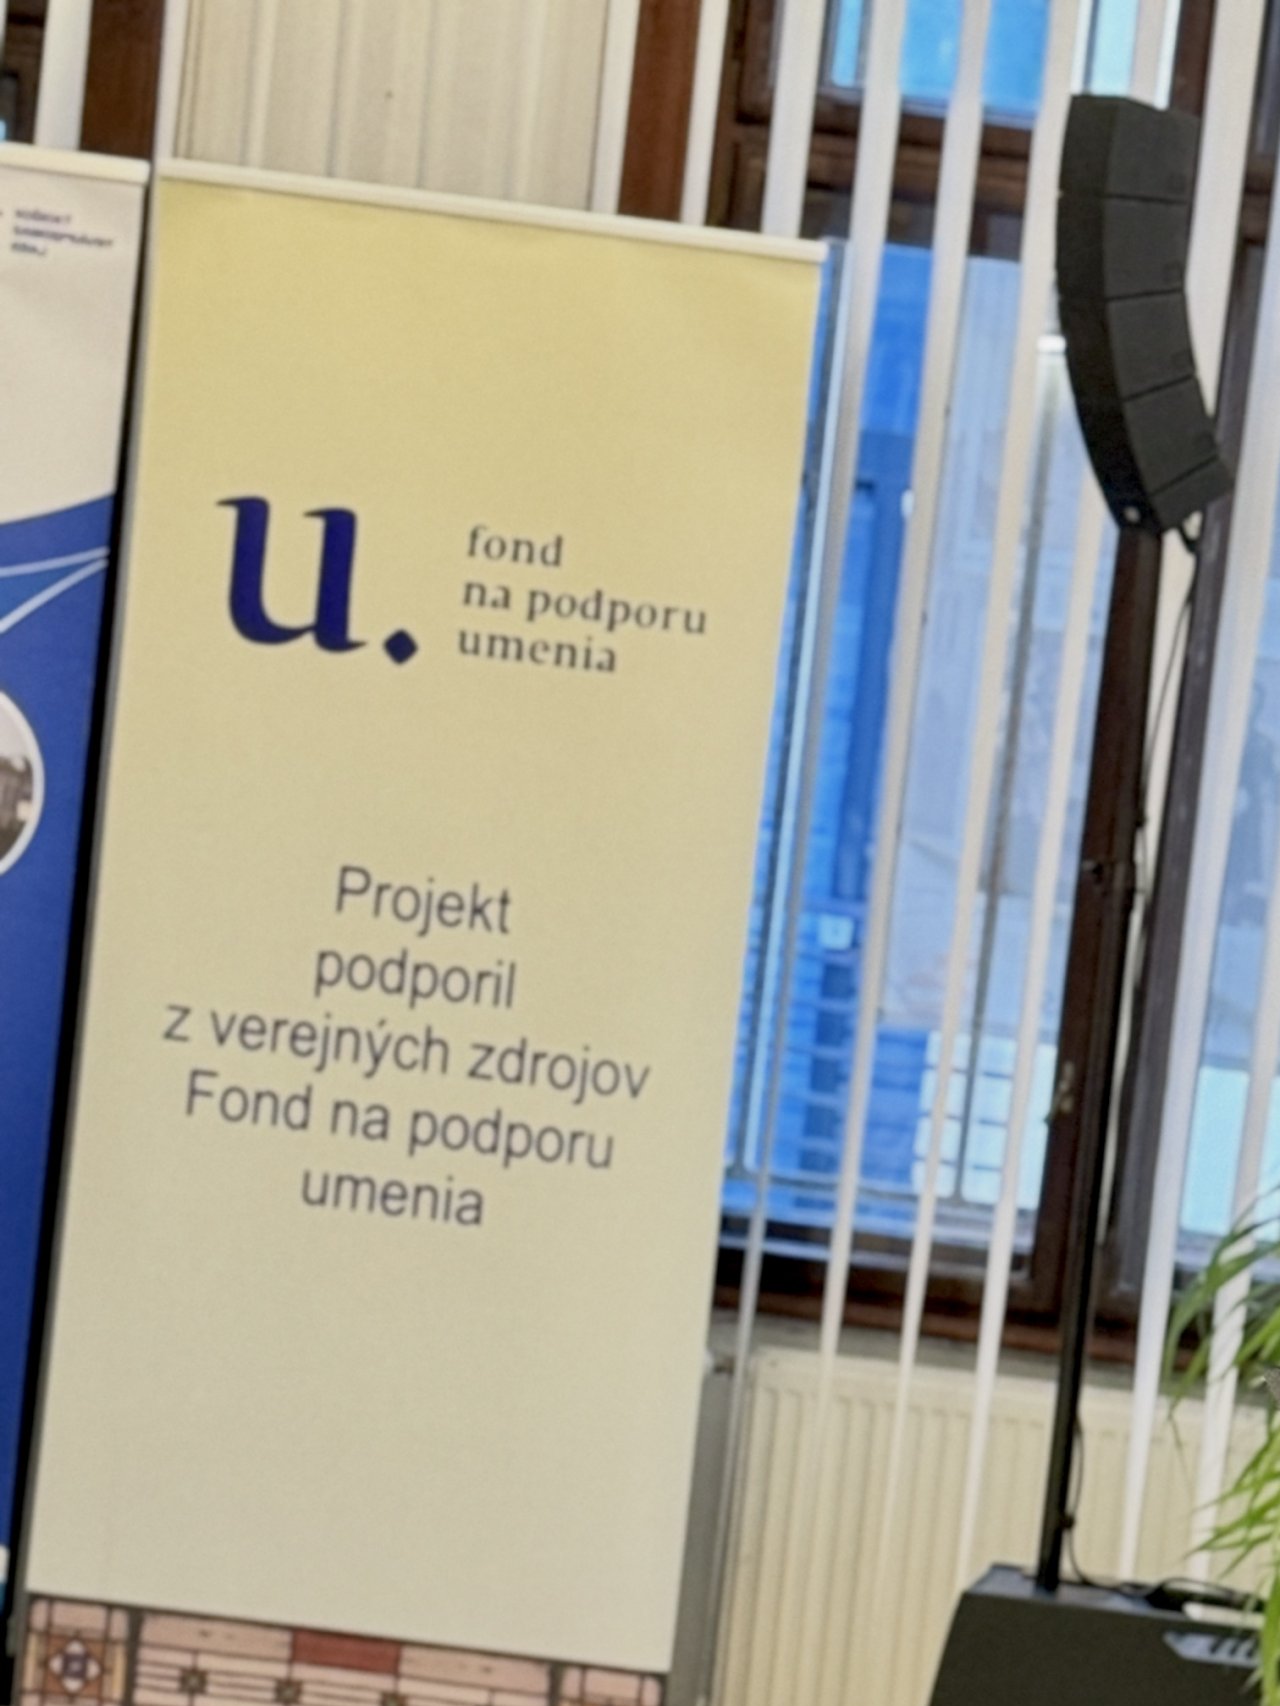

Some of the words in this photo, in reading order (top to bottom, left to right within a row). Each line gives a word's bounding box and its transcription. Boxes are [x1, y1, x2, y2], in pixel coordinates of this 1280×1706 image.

[466, 524, 565, 568] fond
[462, 579, 513, 610] na
[526, 586, 709, 635] podporu
[457, 627, 619, 673] umenia
[335, 864, 512, 937] Projekt
[313, 947, 516, 1010] podporil
[162, 1003, 193, 1043] z
[210, 1009, 451, 1079] verejných
[466, 1036, 651, 1106] zdrojov
[185, 1068, 314, 1131] Fond
[329, 1097, 391, 1142] na
[408, 1107, 615, 1170] podporu
[300, 1169, 487, 1227] umenia
